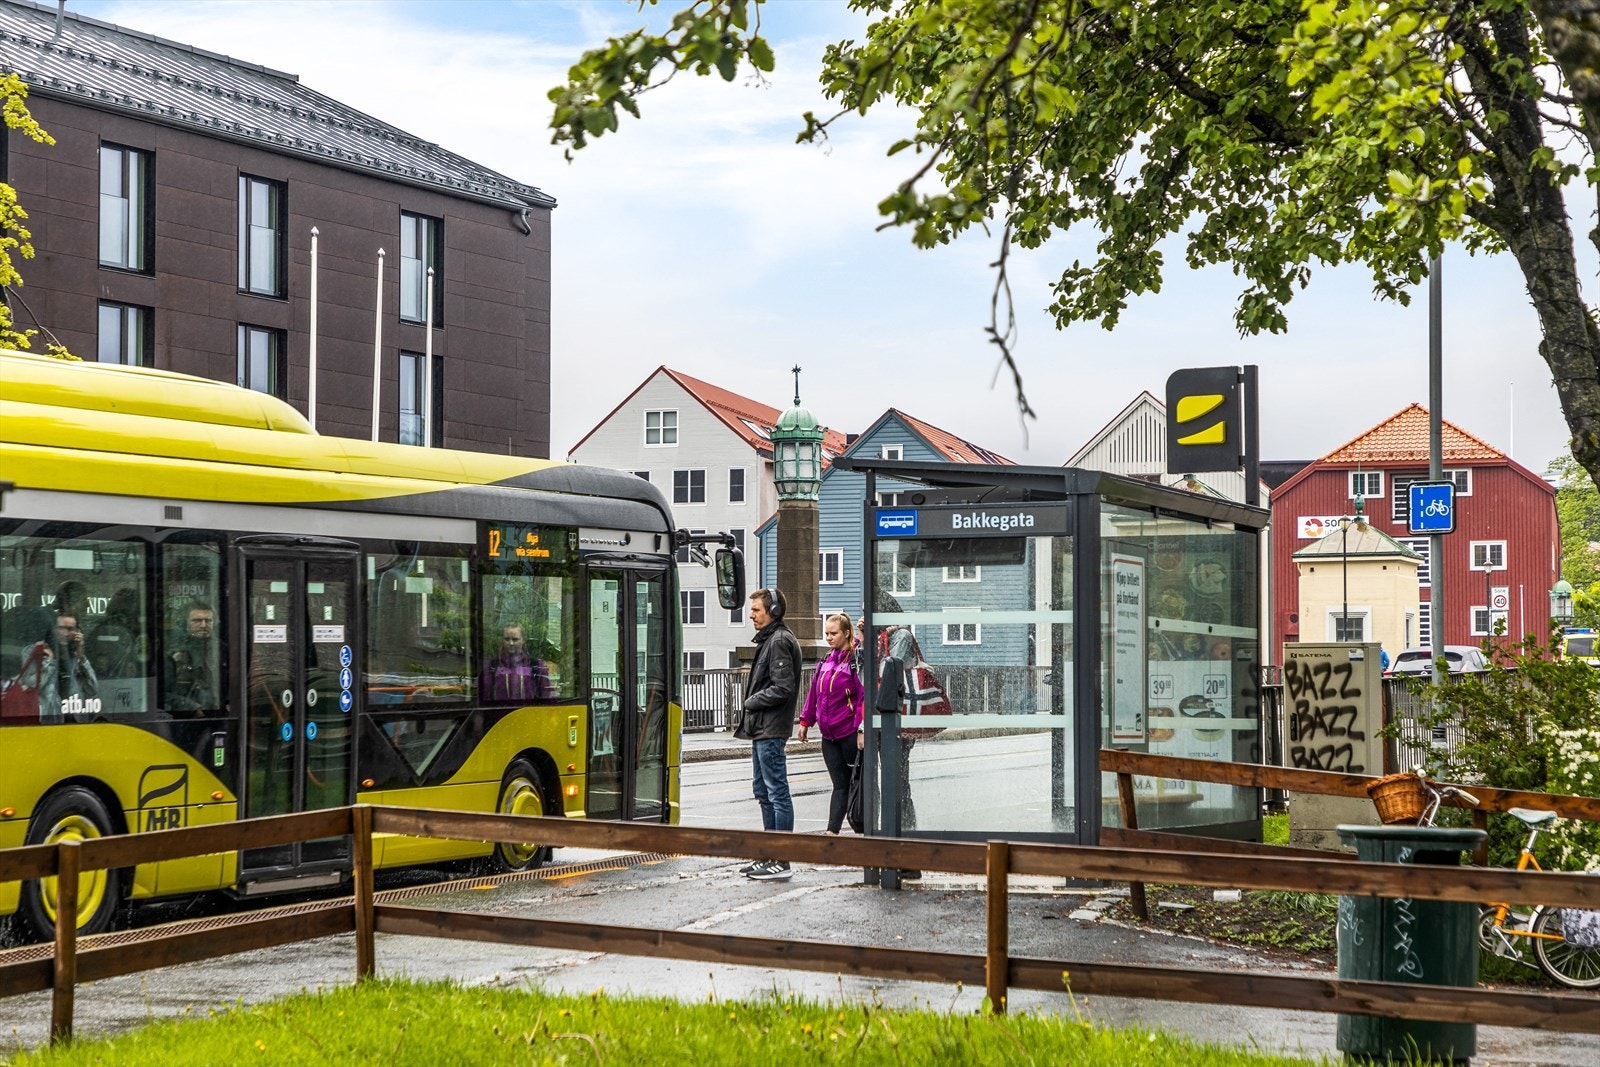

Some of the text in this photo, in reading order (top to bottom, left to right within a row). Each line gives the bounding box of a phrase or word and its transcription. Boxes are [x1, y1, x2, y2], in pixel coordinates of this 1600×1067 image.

[952, 512, 1035, 531] Bakkegata
[489, 530, 501, 557] 12
[1127, 572, 1140, 587] billett
[1123, 591, 1139, 606] forhånd
[1153, 680, 1165, 695] 39
[1206, 680, 1218, 695] 20
[1284, 661, 1361, 701] BAZZ
[61, 694, 102, 714] atb.no
[1296, 700, 1365, 742] BAZZ
